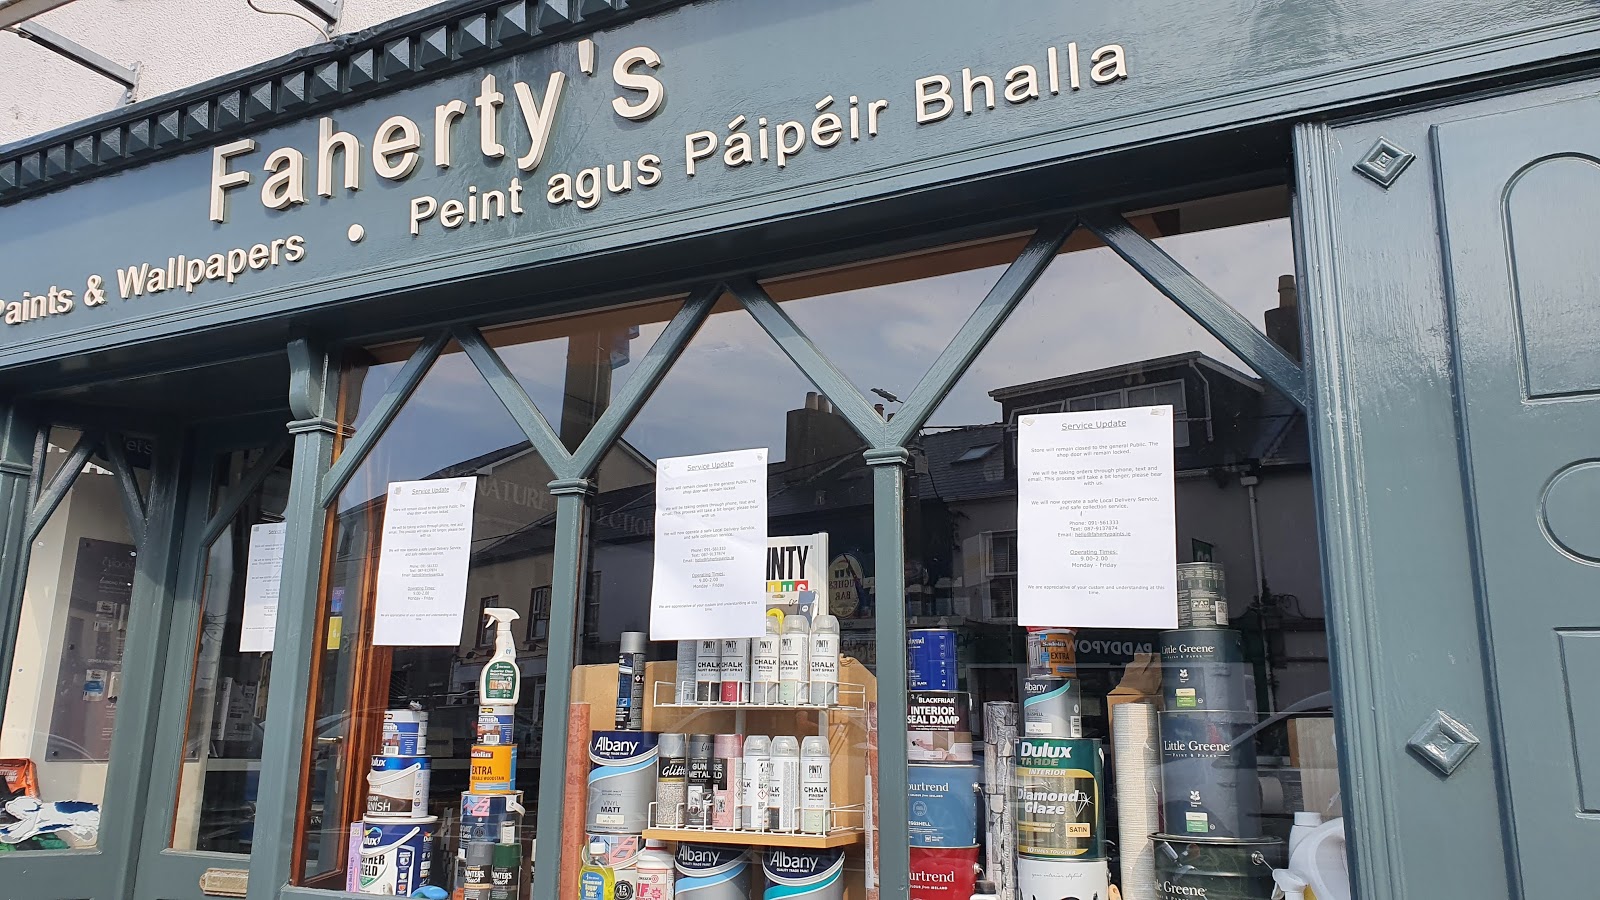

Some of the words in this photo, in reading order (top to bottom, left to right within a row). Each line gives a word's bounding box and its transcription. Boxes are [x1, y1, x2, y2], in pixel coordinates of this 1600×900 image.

[209, 39, 665, 223] Faherty's
[410, 177, 523, 235] Peint
[547, 154, 662, 210] agus
[684, 95, 888, 177] Páipéir
[915, 42, 1128, 125] Bhalla
[83, 274, 105, 306] &
[117, 233, 305, 299] Wallpapers
[1061, 422, 1093, 430] Service
[1095, 420, 1126, 429] Update
[766, 546, 808, 580] INTY
[1179, 644, 1214, 653] Greene
[1024, 682, 1046, 693] Albany
[911, 706, 955, 715] INTERIOR
[908, 716, 929, 724] SEAL
[930, 716, 960, 725] DAMP
[594, 736, 639, 755] Albany
[1021, 742, 1072, 758] Dulux
[1164, 741, 1185, 750] Little
[1189, 741, 1230, 751] Greene
[1021, 758, 1059, 767] TRADE
[662, 764, 685, 777] Glitt
[809, 765, 822, 774] PINTY
[908, 782, 949, 792] ourtrend
[1018, 788, 1079, 802] Diamond
[1025, 802, 1065, 815] Glaze
[678, 845, 720, 866] Albany
[770, 851, 819, 872] Albany
[909, 871, 955, 882] urtrend
[1164, 881, 1205, 896] Greene
